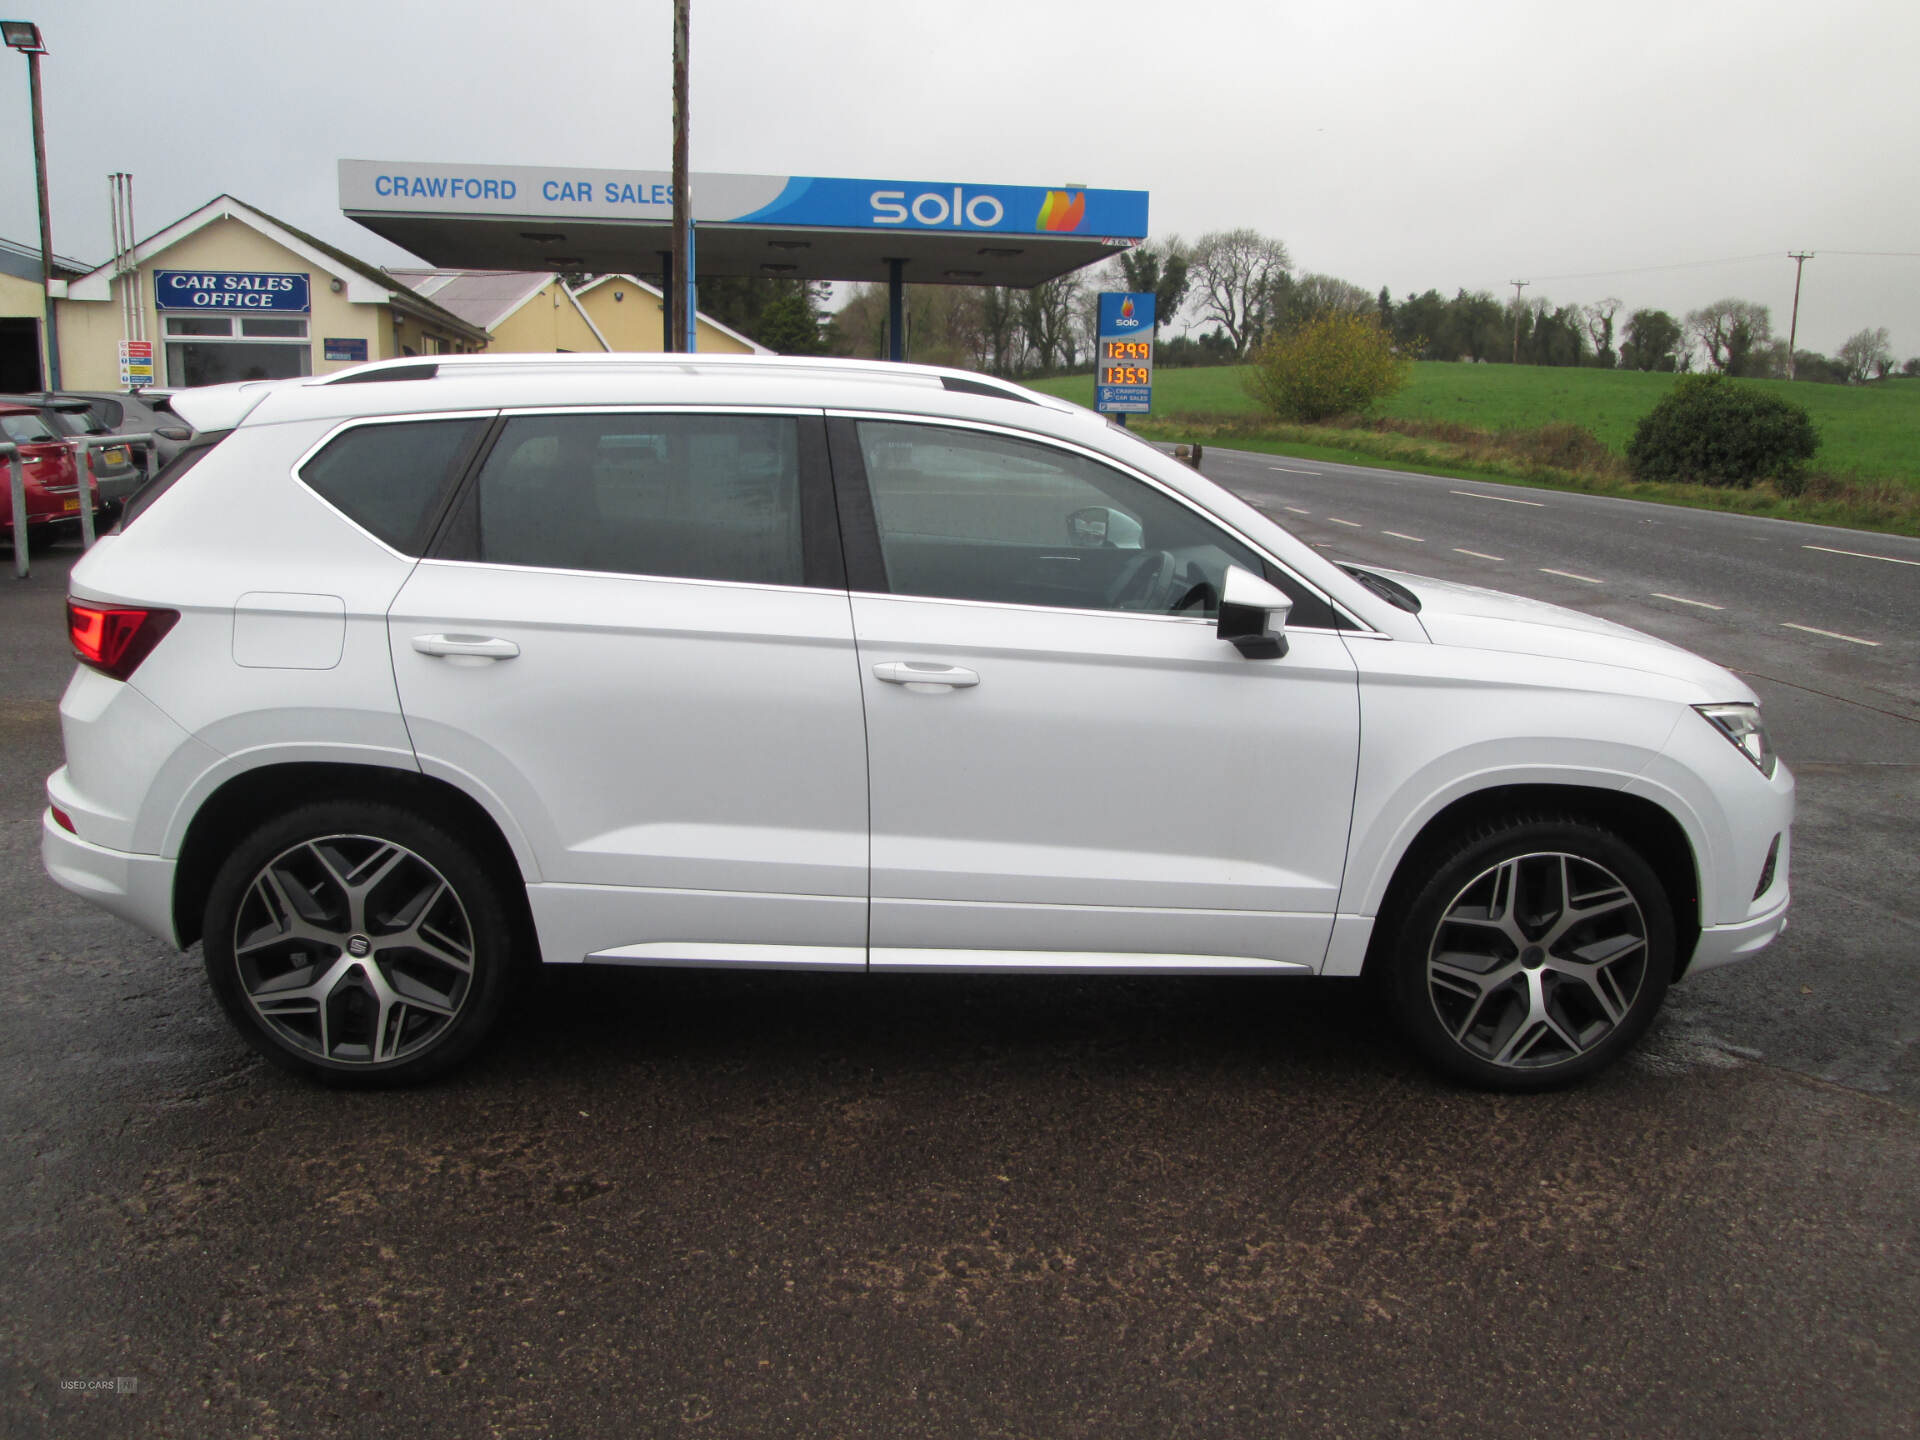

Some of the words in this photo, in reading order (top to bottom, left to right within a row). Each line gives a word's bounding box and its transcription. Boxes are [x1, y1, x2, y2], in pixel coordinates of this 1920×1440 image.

[375, 175, 517, 201] CRAWFORD
[542, 180, 593, 202] CAR
[870, 187, 1004, 227] solo
[171, 275, 217, 289] CAR
[224, 276, 294, 291] SALES
[192, 292, 274, 307] OFFICE
[1115, 318, 1139, 327] solo
[1108, 341, 1149, 359] 129.9
[1107, 367, 1148, 385] 135.9
